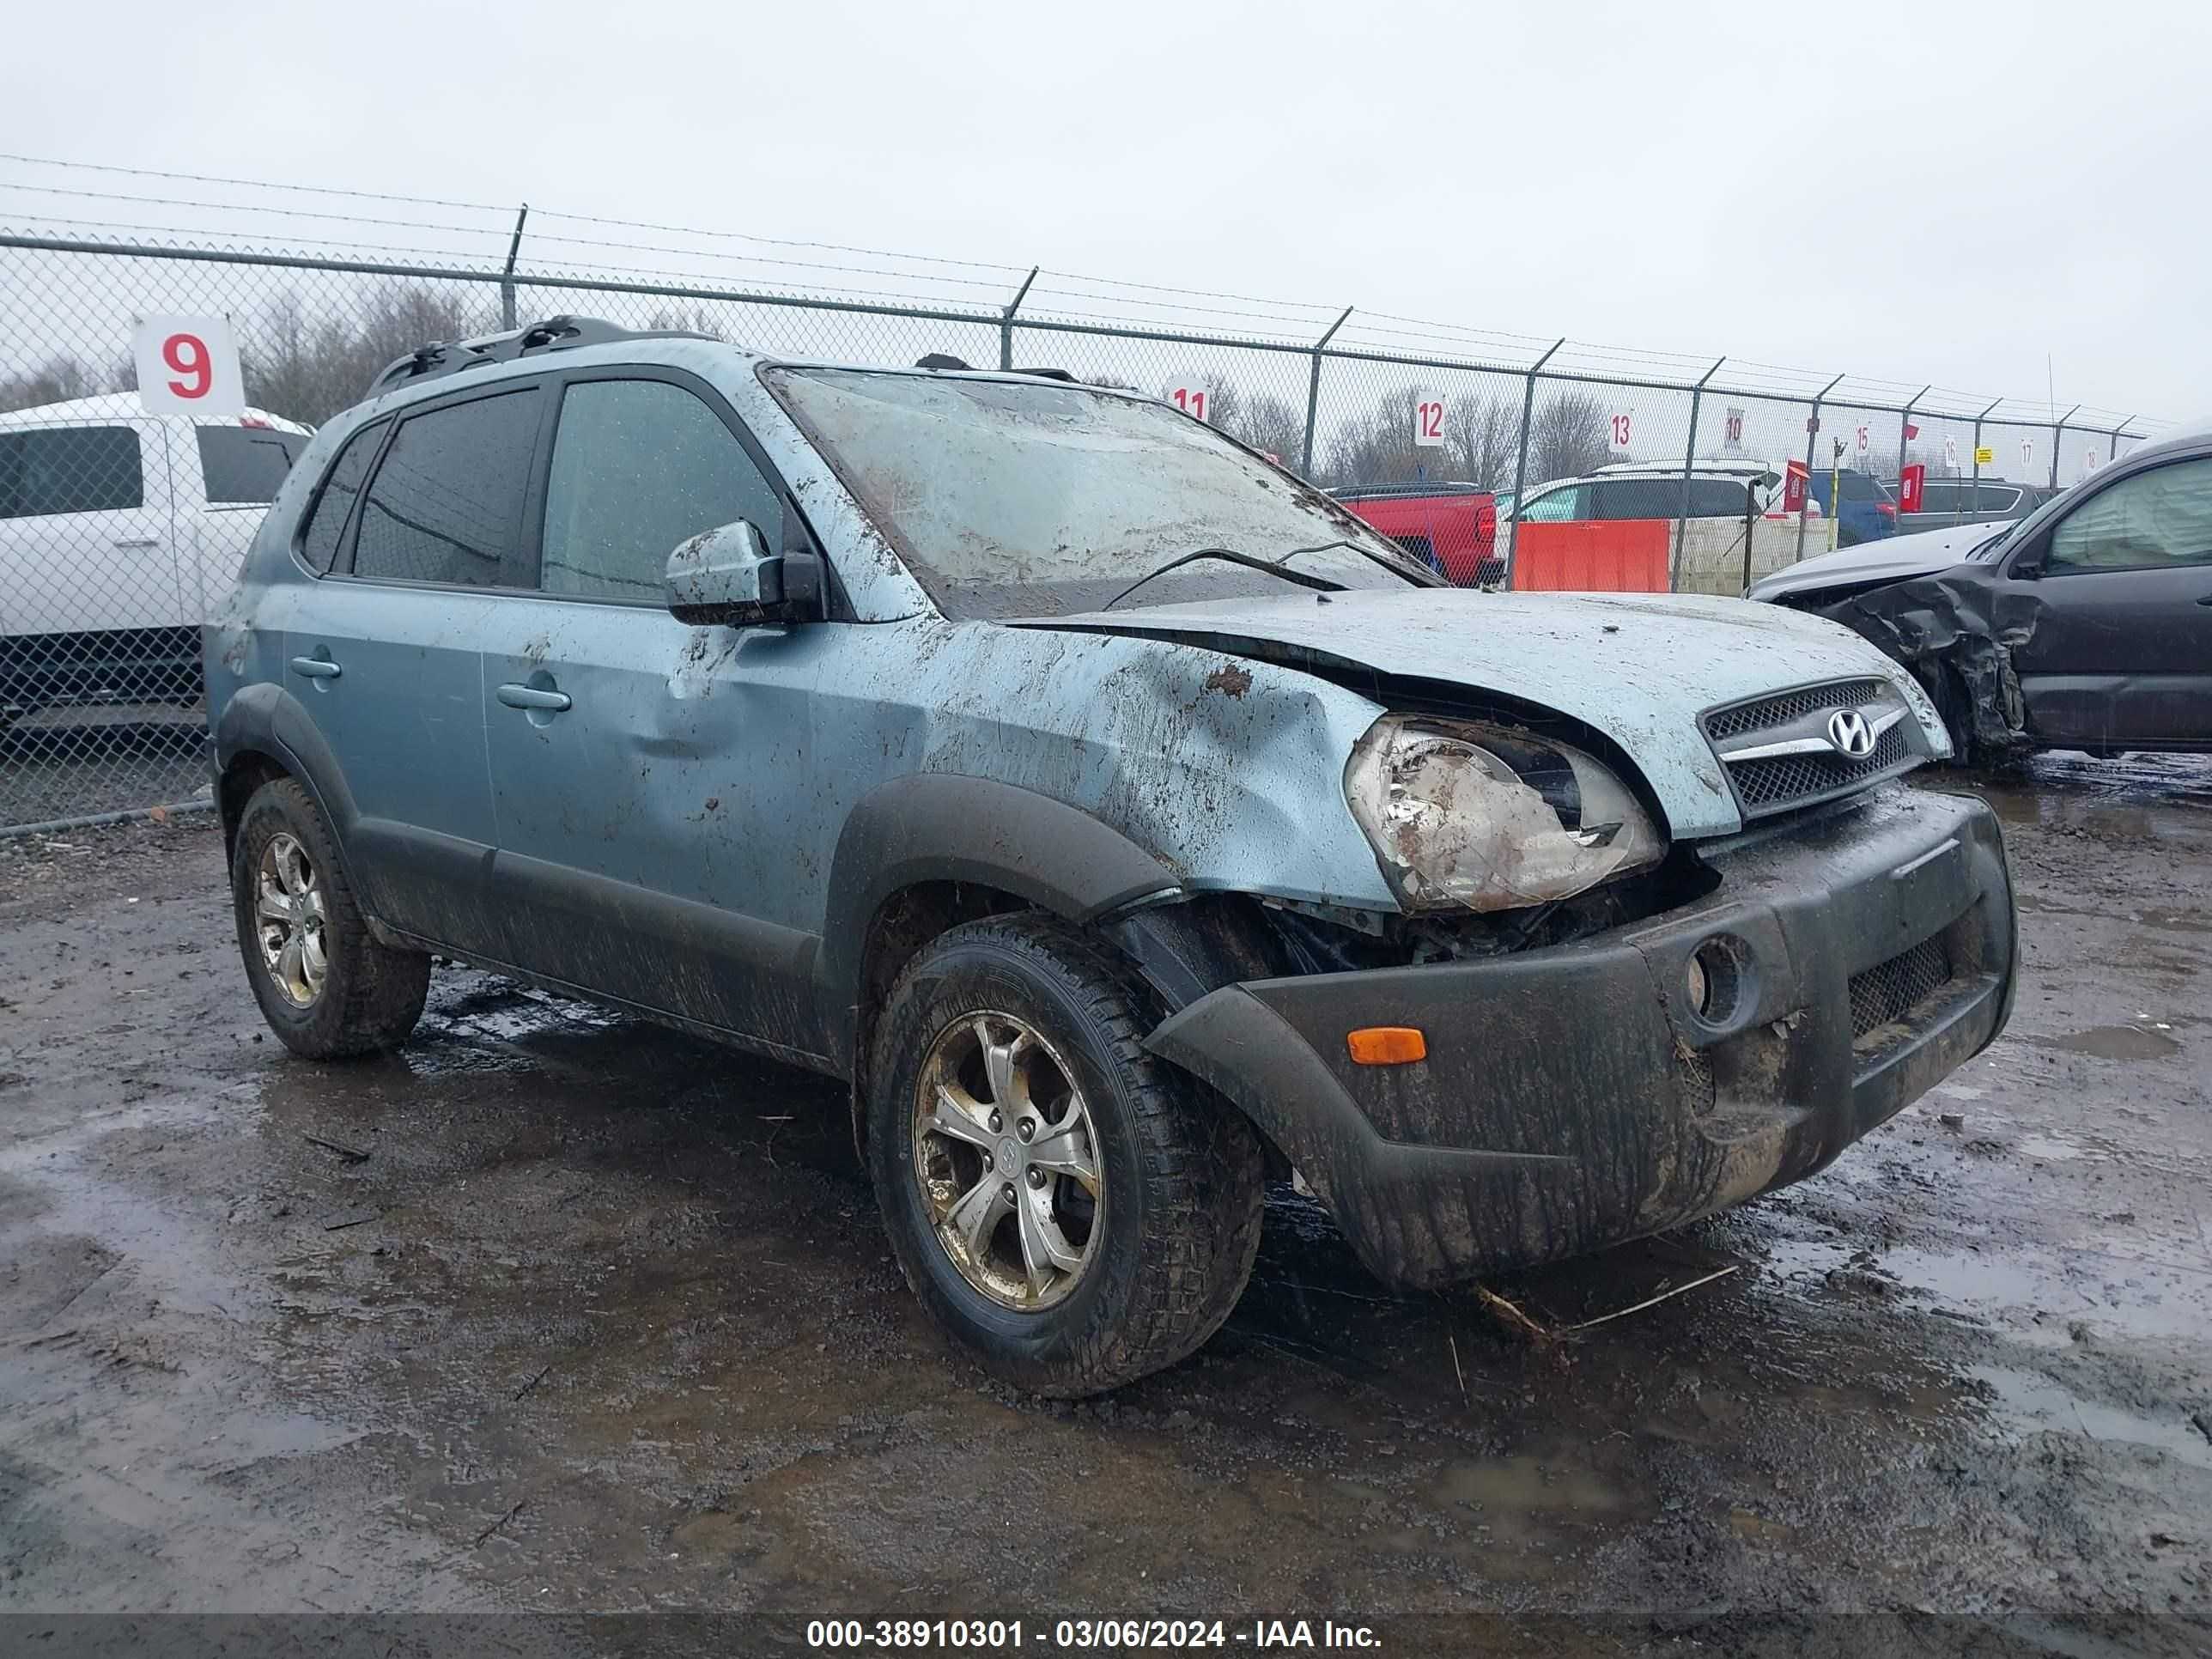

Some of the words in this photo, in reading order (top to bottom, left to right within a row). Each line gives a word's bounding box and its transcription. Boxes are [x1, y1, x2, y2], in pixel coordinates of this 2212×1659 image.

[162, 334, 212, 398] 9
[1174, 388, 1205, 421] 11
[1419, 403, 1443, 437] 12
[1612, 416, 1629, 445] 13
[1857, 427, 1868, 451] 15
[1947, 439, 1957, 462] 16
[2023, 444, 2033, 462] 17
